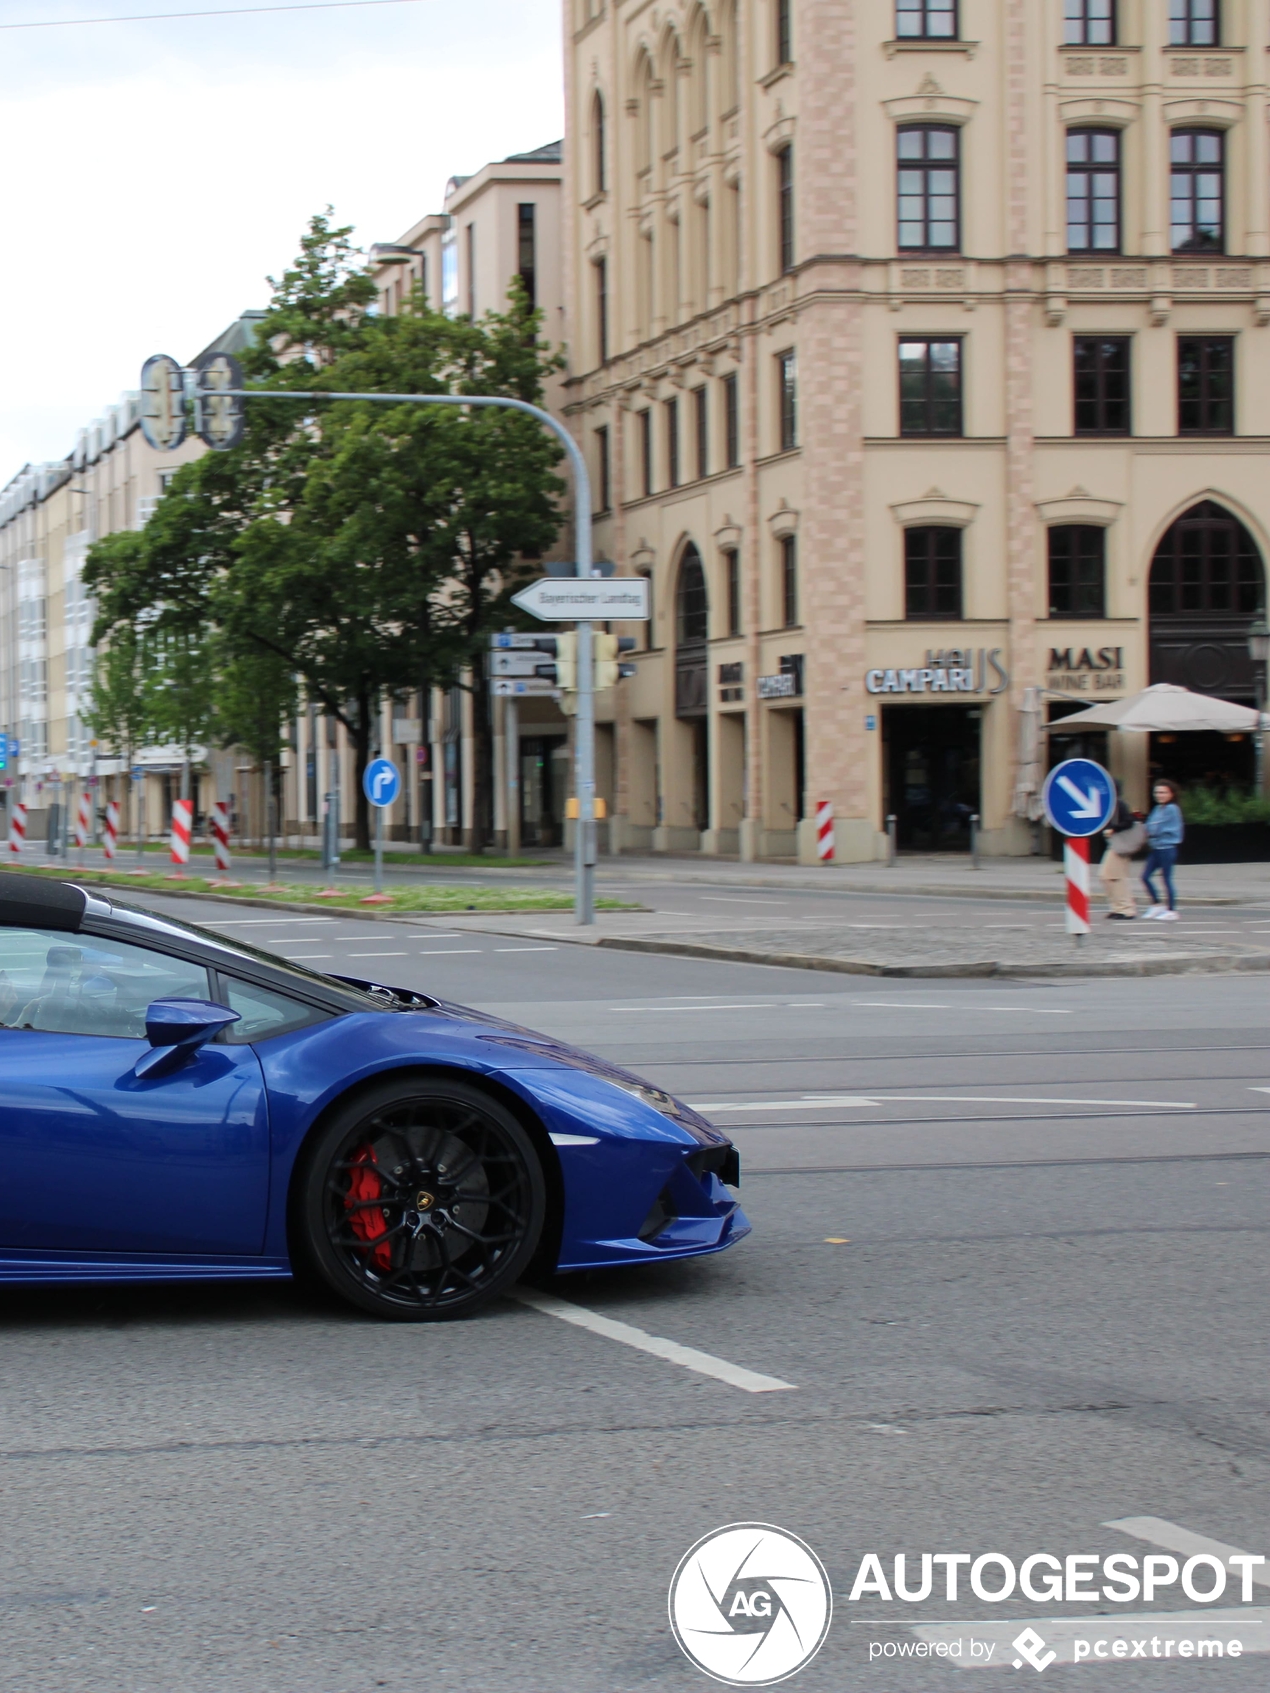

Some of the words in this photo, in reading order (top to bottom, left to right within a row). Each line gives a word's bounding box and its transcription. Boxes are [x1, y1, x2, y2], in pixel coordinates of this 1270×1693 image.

[1047, 646, 1125, 671] MASI
[866, 668, 974, 694] CAMPARI
[1045, 674, 1089, 690] WINE
[1093, 674, 1126, 690] BAR
